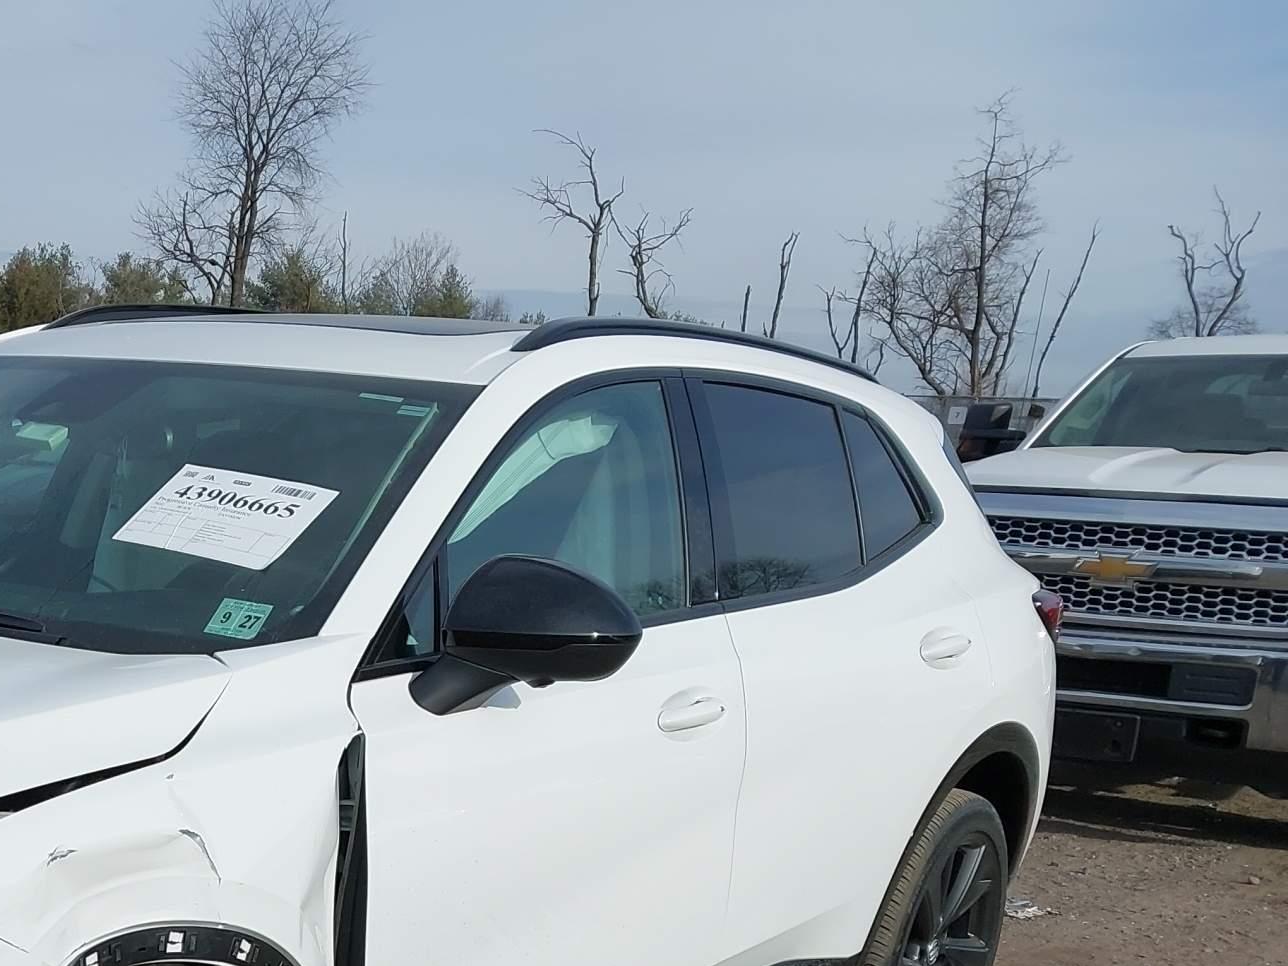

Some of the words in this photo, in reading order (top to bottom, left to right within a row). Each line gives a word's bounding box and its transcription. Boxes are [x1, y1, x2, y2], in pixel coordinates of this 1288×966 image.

[174, 485, 301, 518] 43906665
[220, 611, 232, 624] 9
[238, 614, 262, 630] 27
